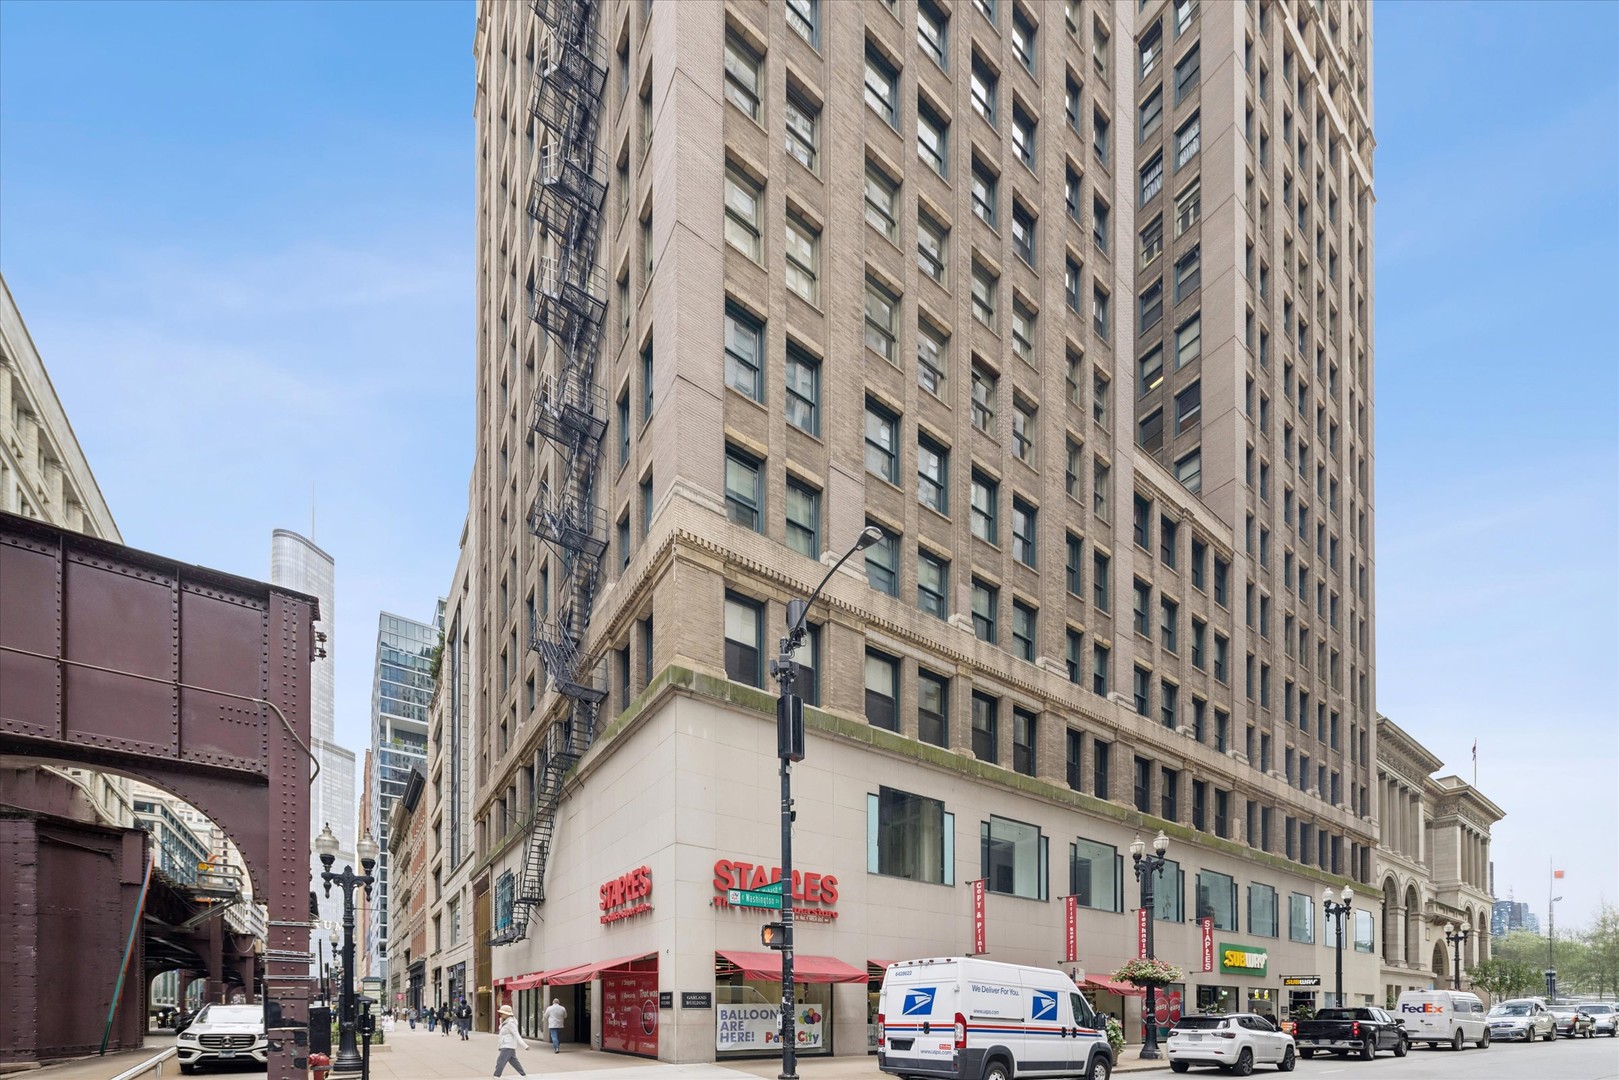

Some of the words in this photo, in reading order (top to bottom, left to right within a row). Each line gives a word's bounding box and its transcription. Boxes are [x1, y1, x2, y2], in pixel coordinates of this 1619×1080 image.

[599, 865, 653, 911] STAPLES
[745, 894, 775, 906] Washington
[1204, 919, 1212, 971] STAPLES
[1223, 950, 1267, 969] SUBWAY
[640, 988, 649, 998] That
[972, 984, 981, 993] We
[982, 985, 1000, 994] Deliver
[1001, 987, 1009, 995] For
[1401, 1003, 1443, 1013] FedEx
[720, 1009, 779, 1020] BALLOON
[720, 1021, 744, 1031] ARE
[720, 1031, 755, 1043] HERE!
[797, 1030, 819, 1044] City
